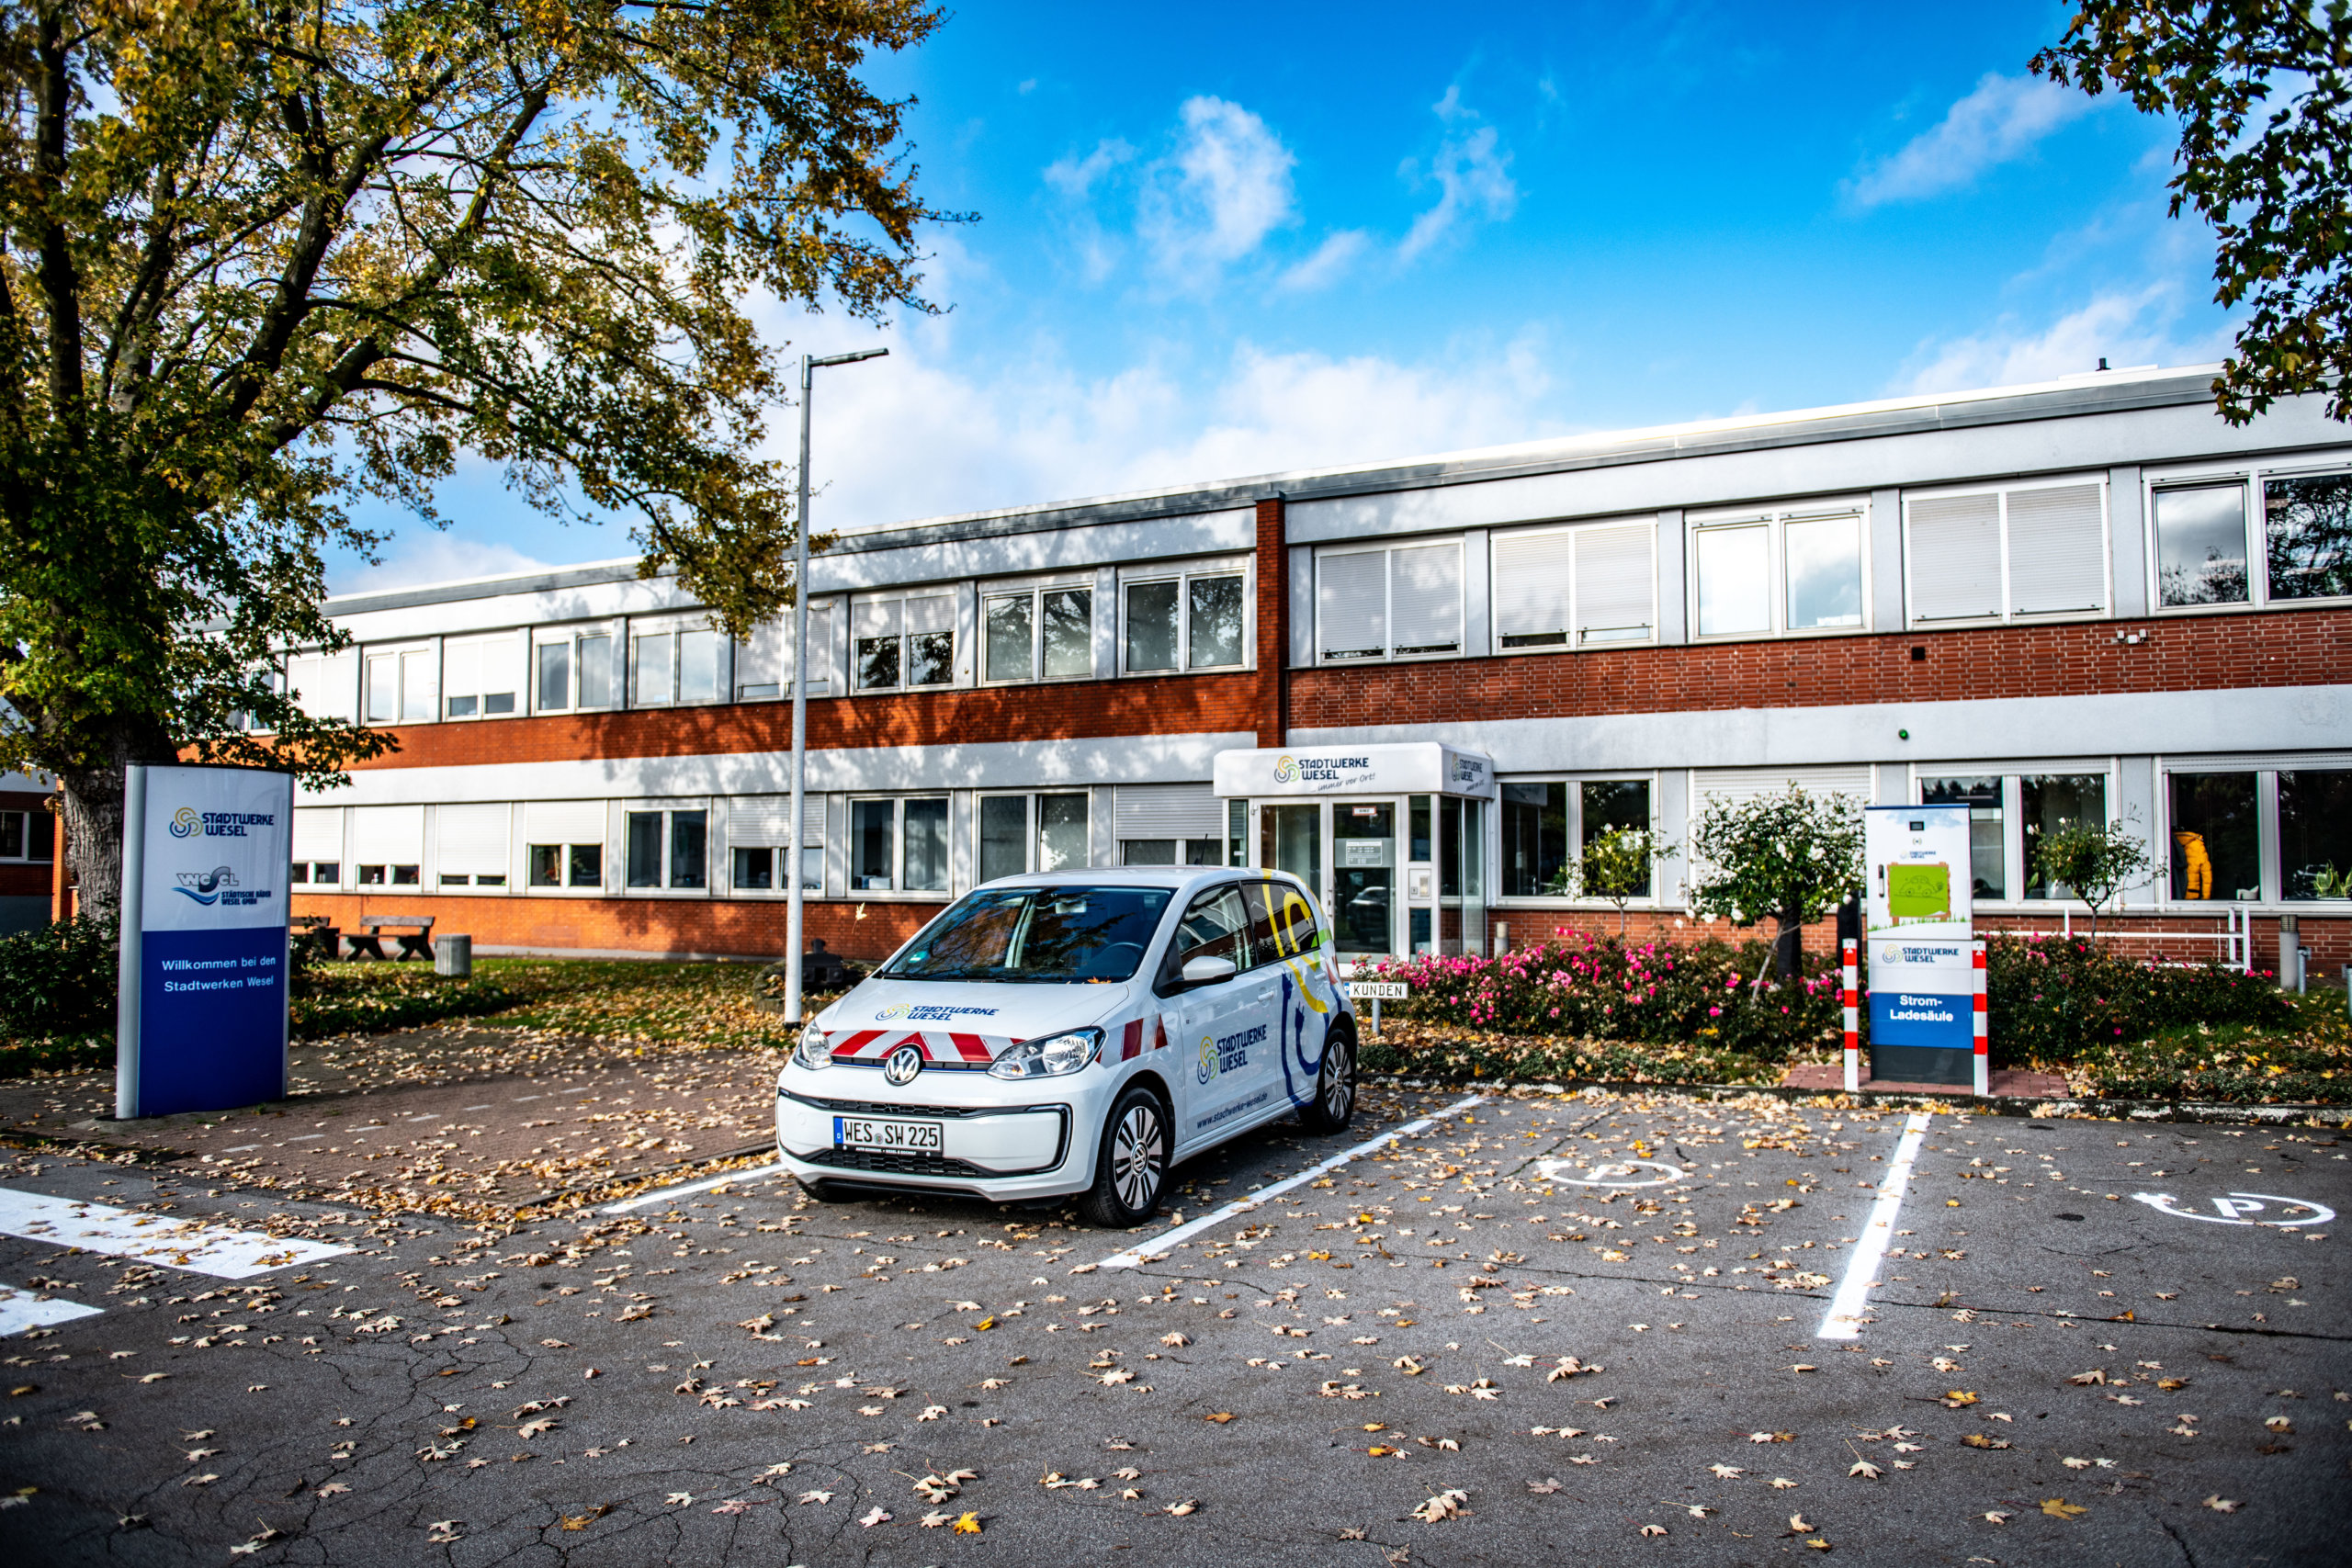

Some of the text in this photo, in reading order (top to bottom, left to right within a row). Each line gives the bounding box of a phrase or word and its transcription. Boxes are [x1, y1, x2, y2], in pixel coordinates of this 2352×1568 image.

[1298, 757, 1369, 770] STADTWERKE
[1301, 770, 1340, 781] WESEL
[202, 812, 274, 826] STADTWERKE
[206, 825, 248, 837] WESEL
[1902, 947, 1959, 956] STADTWERKE
[162, 955, 276, 971] Willkommen bei den
[1905, 955, 1936, 964] WESEL
[164, 975, 274, 992] Stadtwerken Wesel
[1353, 984, 1402, 997] KUNDEN
[1899, 995, 1943, 1007] Strom-
[907, 1012, 953, 1021] WESEL
[910, 1005, 1000, 1016] STADTWERKE
[1890, 1009, 1954, 1021] Ladesäule
[1216, 1024, 1267, 1056] STADTWERKE
[1219, 1049, 1249, 1074] WESEL
[1197, 1092, 1268, 1129] www.stadtwerke-wesel.de
[844, 1122, 873, 1143] WES
[885, 1124, 904, 1145] SW
[908, 1126, 938, 1147] 225
